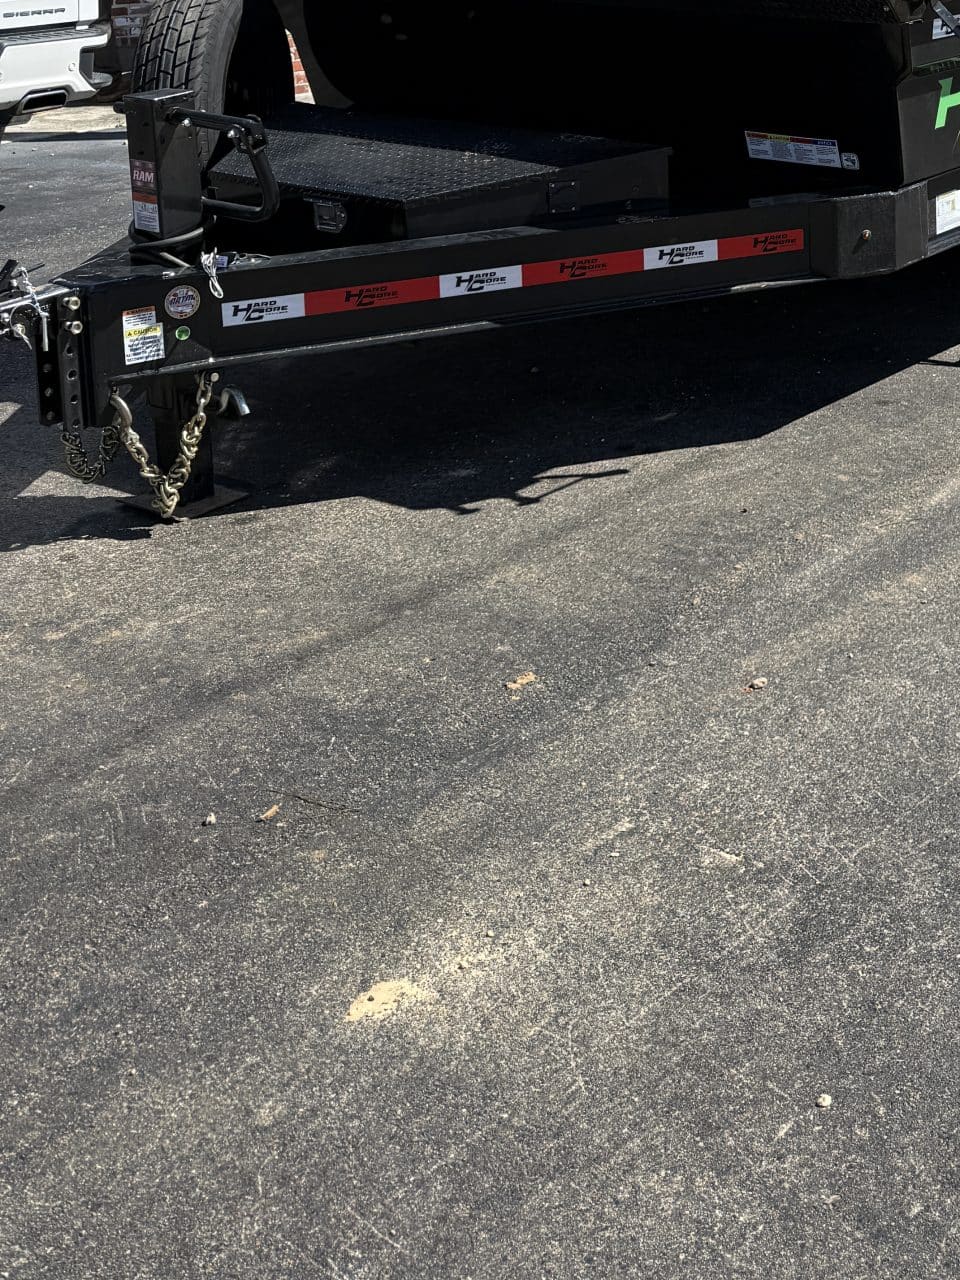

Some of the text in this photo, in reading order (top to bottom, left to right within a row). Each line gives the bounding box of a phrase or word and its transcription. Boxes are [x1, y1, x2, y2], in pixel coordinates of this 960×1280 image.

[133, 170, 154, 183] RAM
[231, 300, 277, 318] HARD
[244, 305, 289, 322] CORE
